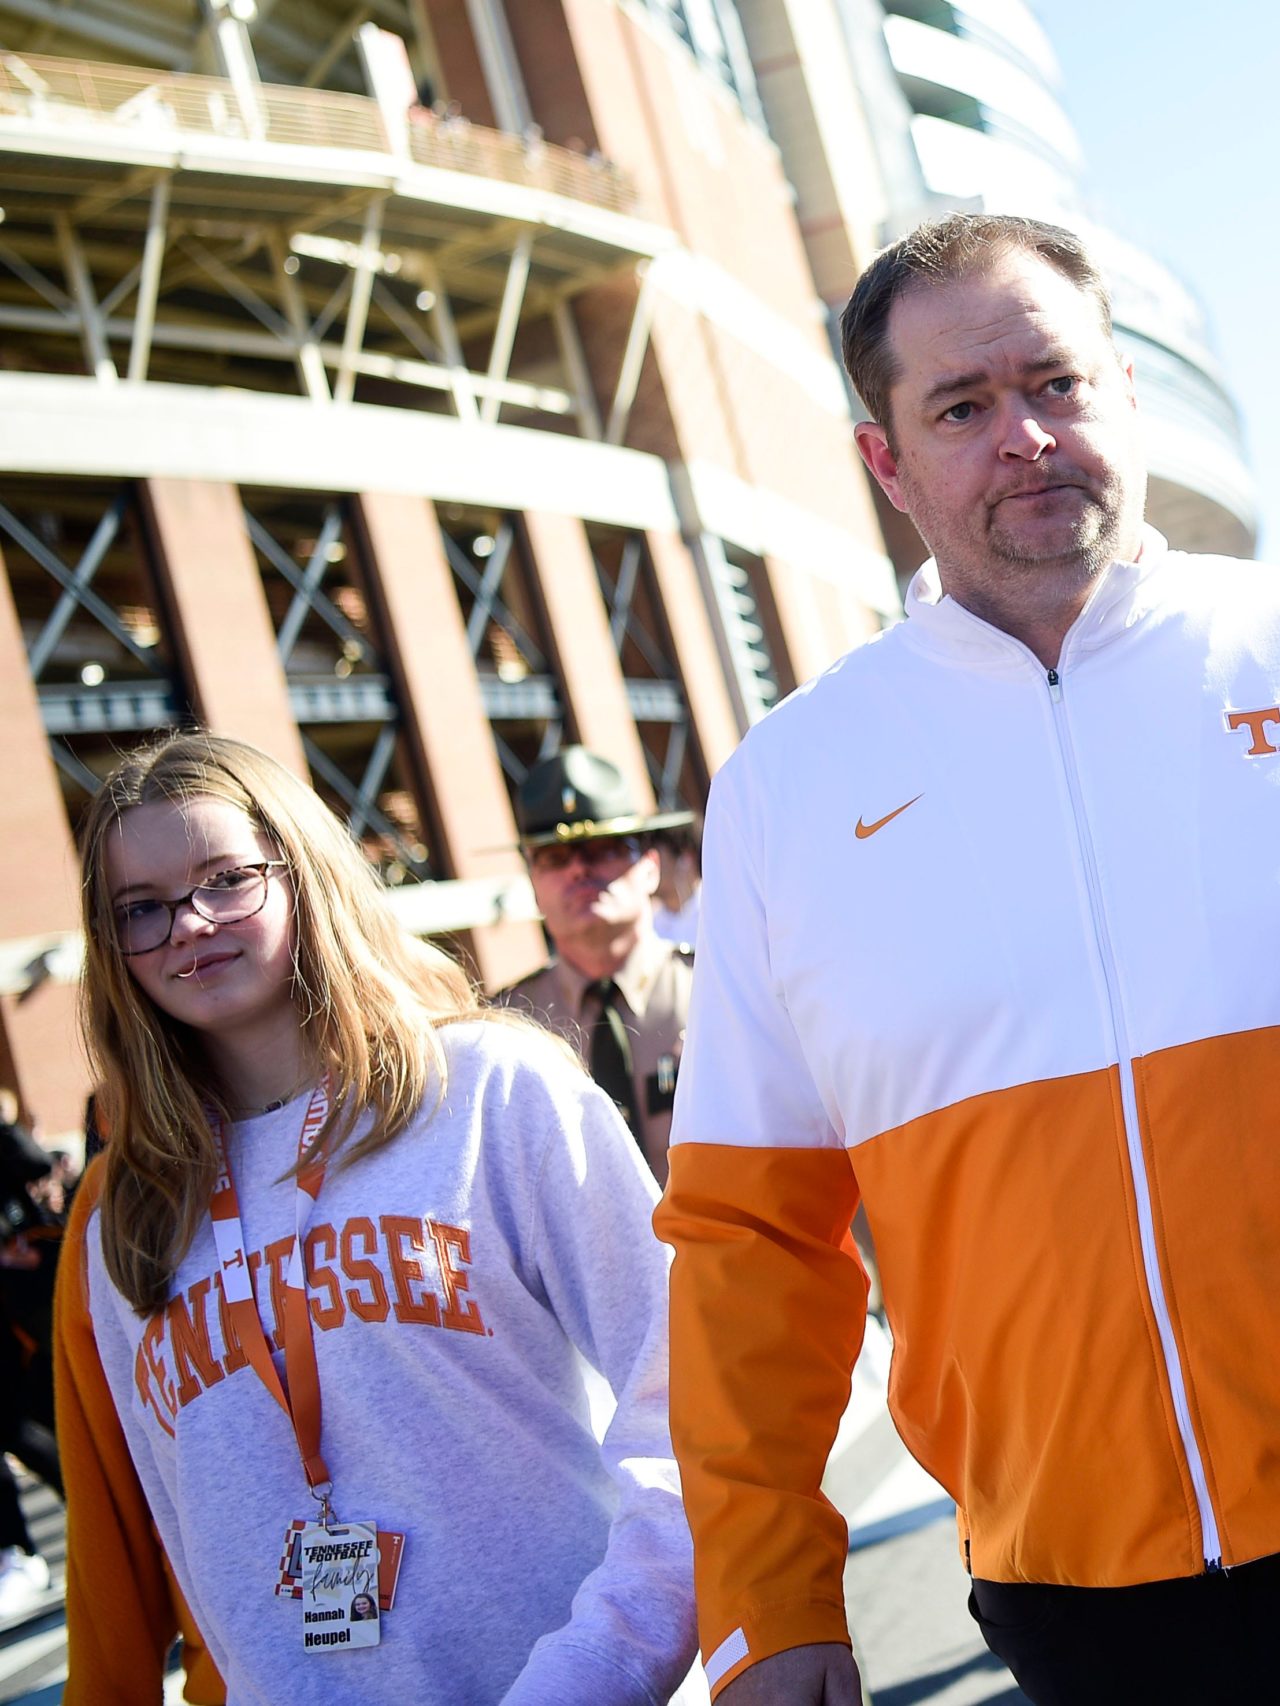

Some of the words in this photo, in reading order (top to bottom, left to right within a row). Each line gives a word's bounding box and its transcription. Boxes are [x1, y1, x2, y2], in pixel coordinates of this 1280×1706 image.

[304, 1540, 373, 1556] TENNESSEE
[309, 1549, 370, 1564] FOOTBALL
[305, 1608, 345, 1624] Hannah
[305, 1628, 351, 1647] Heupel
